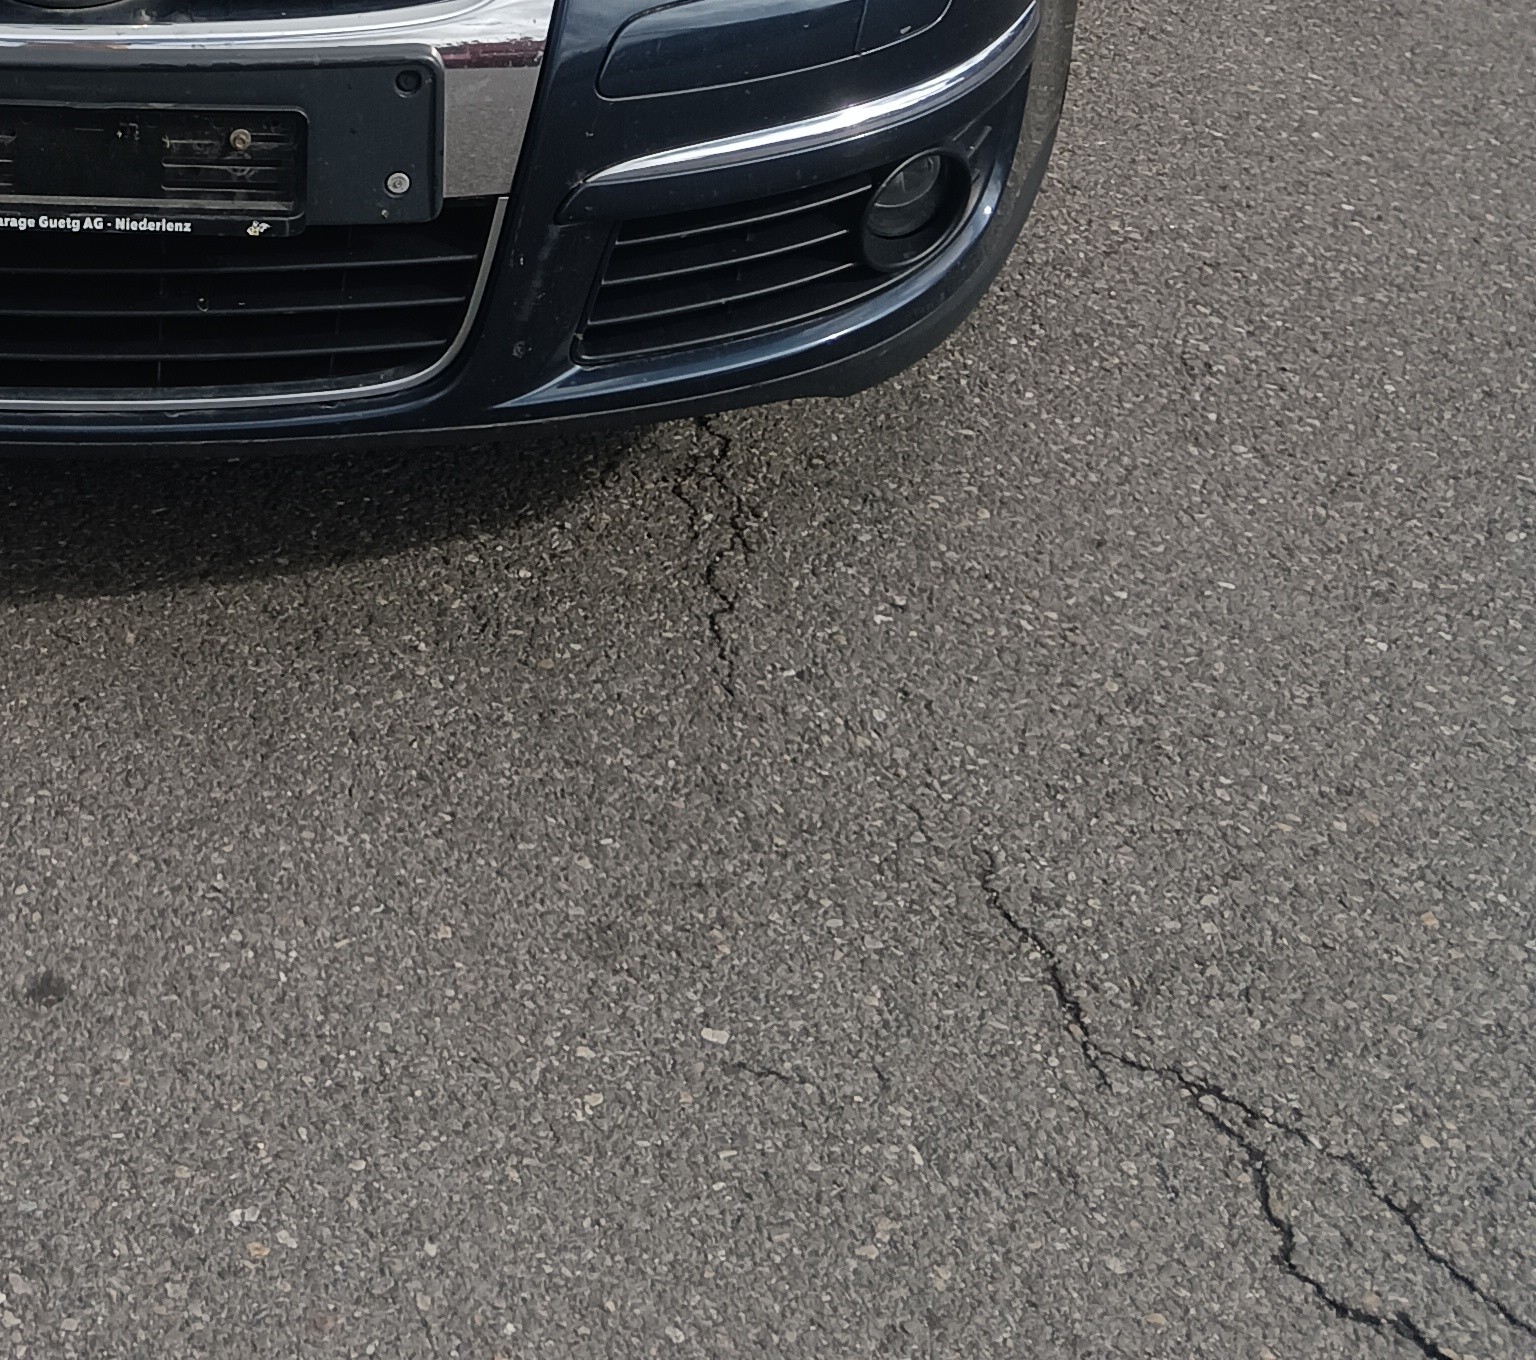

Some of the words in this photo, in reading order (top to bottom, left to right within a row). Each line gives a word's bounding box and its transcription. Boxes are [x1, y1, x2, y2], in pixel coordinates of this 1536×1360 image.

[38, 215, 81, 232] Guetg
[82, 217, 104, 230] AG
[115, 217, 192, 232] Niederlenz
